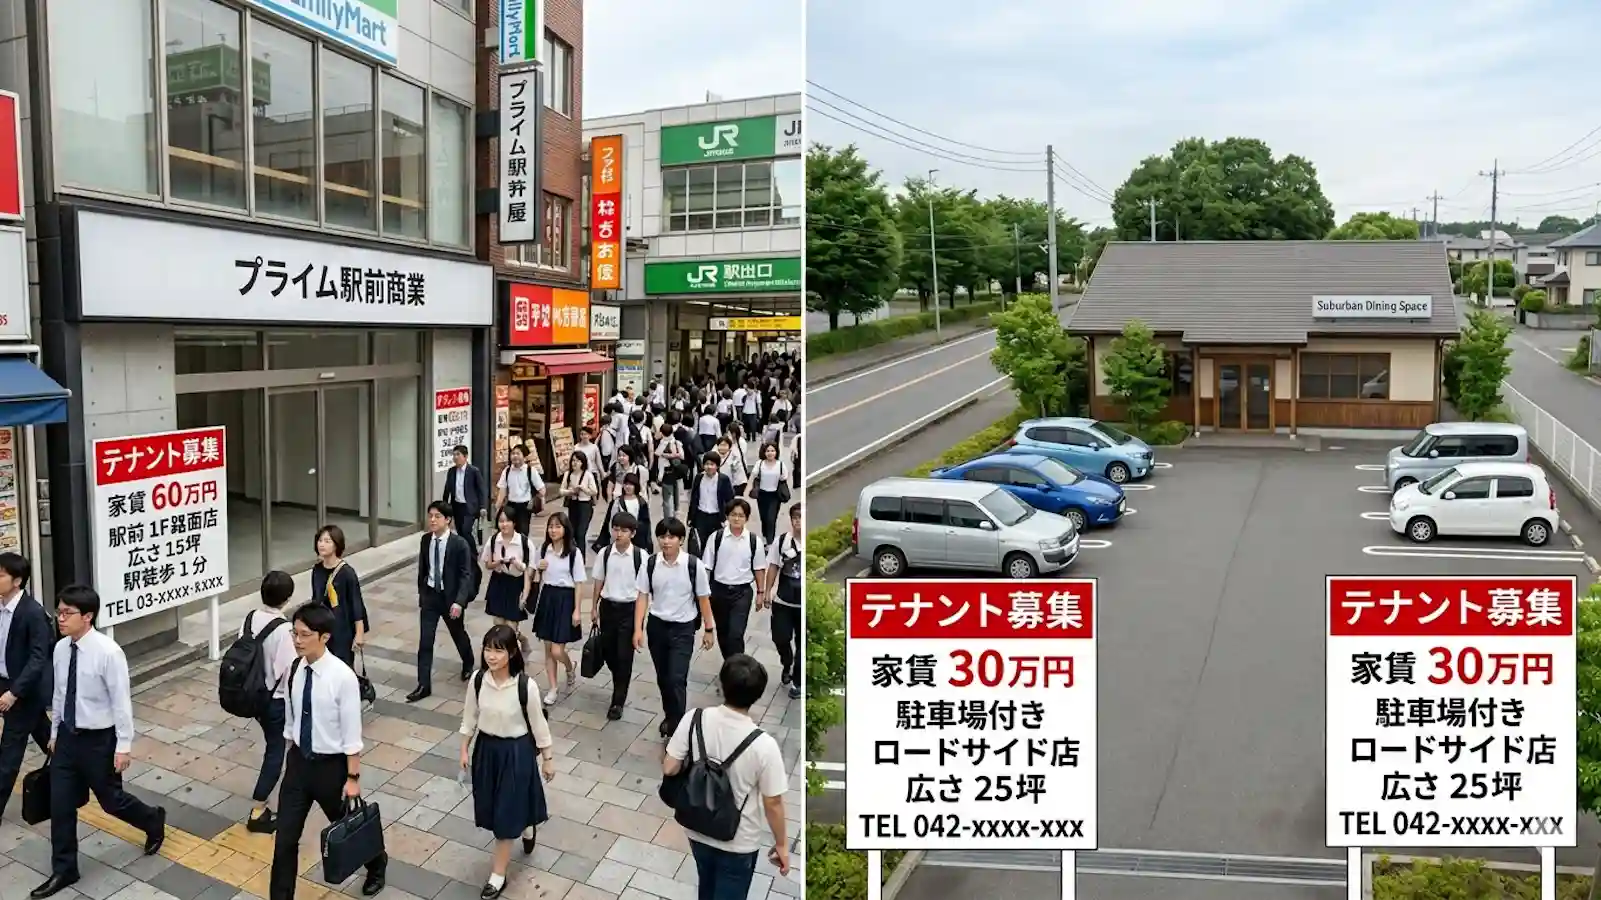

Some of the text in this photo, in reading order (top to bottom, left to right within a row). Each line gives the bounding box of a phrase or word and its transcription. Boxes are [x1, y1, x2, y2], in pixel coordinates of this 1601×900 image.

[698, 124, 739, 150] JR
[234, 255, 426, 307] プライム駅前商業
[687, 265, 718, 283] JR
[1317, 300, 1363, 311] Suburban
[1399, 300, 1428, 314] Space
[102, 436, 220, 477] テナント募集
[107, 480, 218, 518] 家賃 60万円
[108, 523, 145, 548] 駅前
[127, 533, 201, 568] 広さ 15坪
[105, 599, 134, 619] TEL
[861, 590, 1083, 629] テナント募集
[1341, 587, 1563, 626] テナント募集
[871, 648, 1074, 688] 家賃 30万円
[1350, 646, 1553, 685] 家賃 30万円
[896, 699, 1045, 730] 駐車場付き
[1375, 697, 1525, 727] 駐車場付き
[874, 737, 1080, 767] ロードサイド店
[1351, 734, 1557, 764] ロードサイド店
[905, 773, 1047, 804] 広さ 25坪
[1380, 770, 1522, 801] 広さ 25坪
[859, 813, 907, 838] TEL
[1339, 810, 1387, 835] TEL
